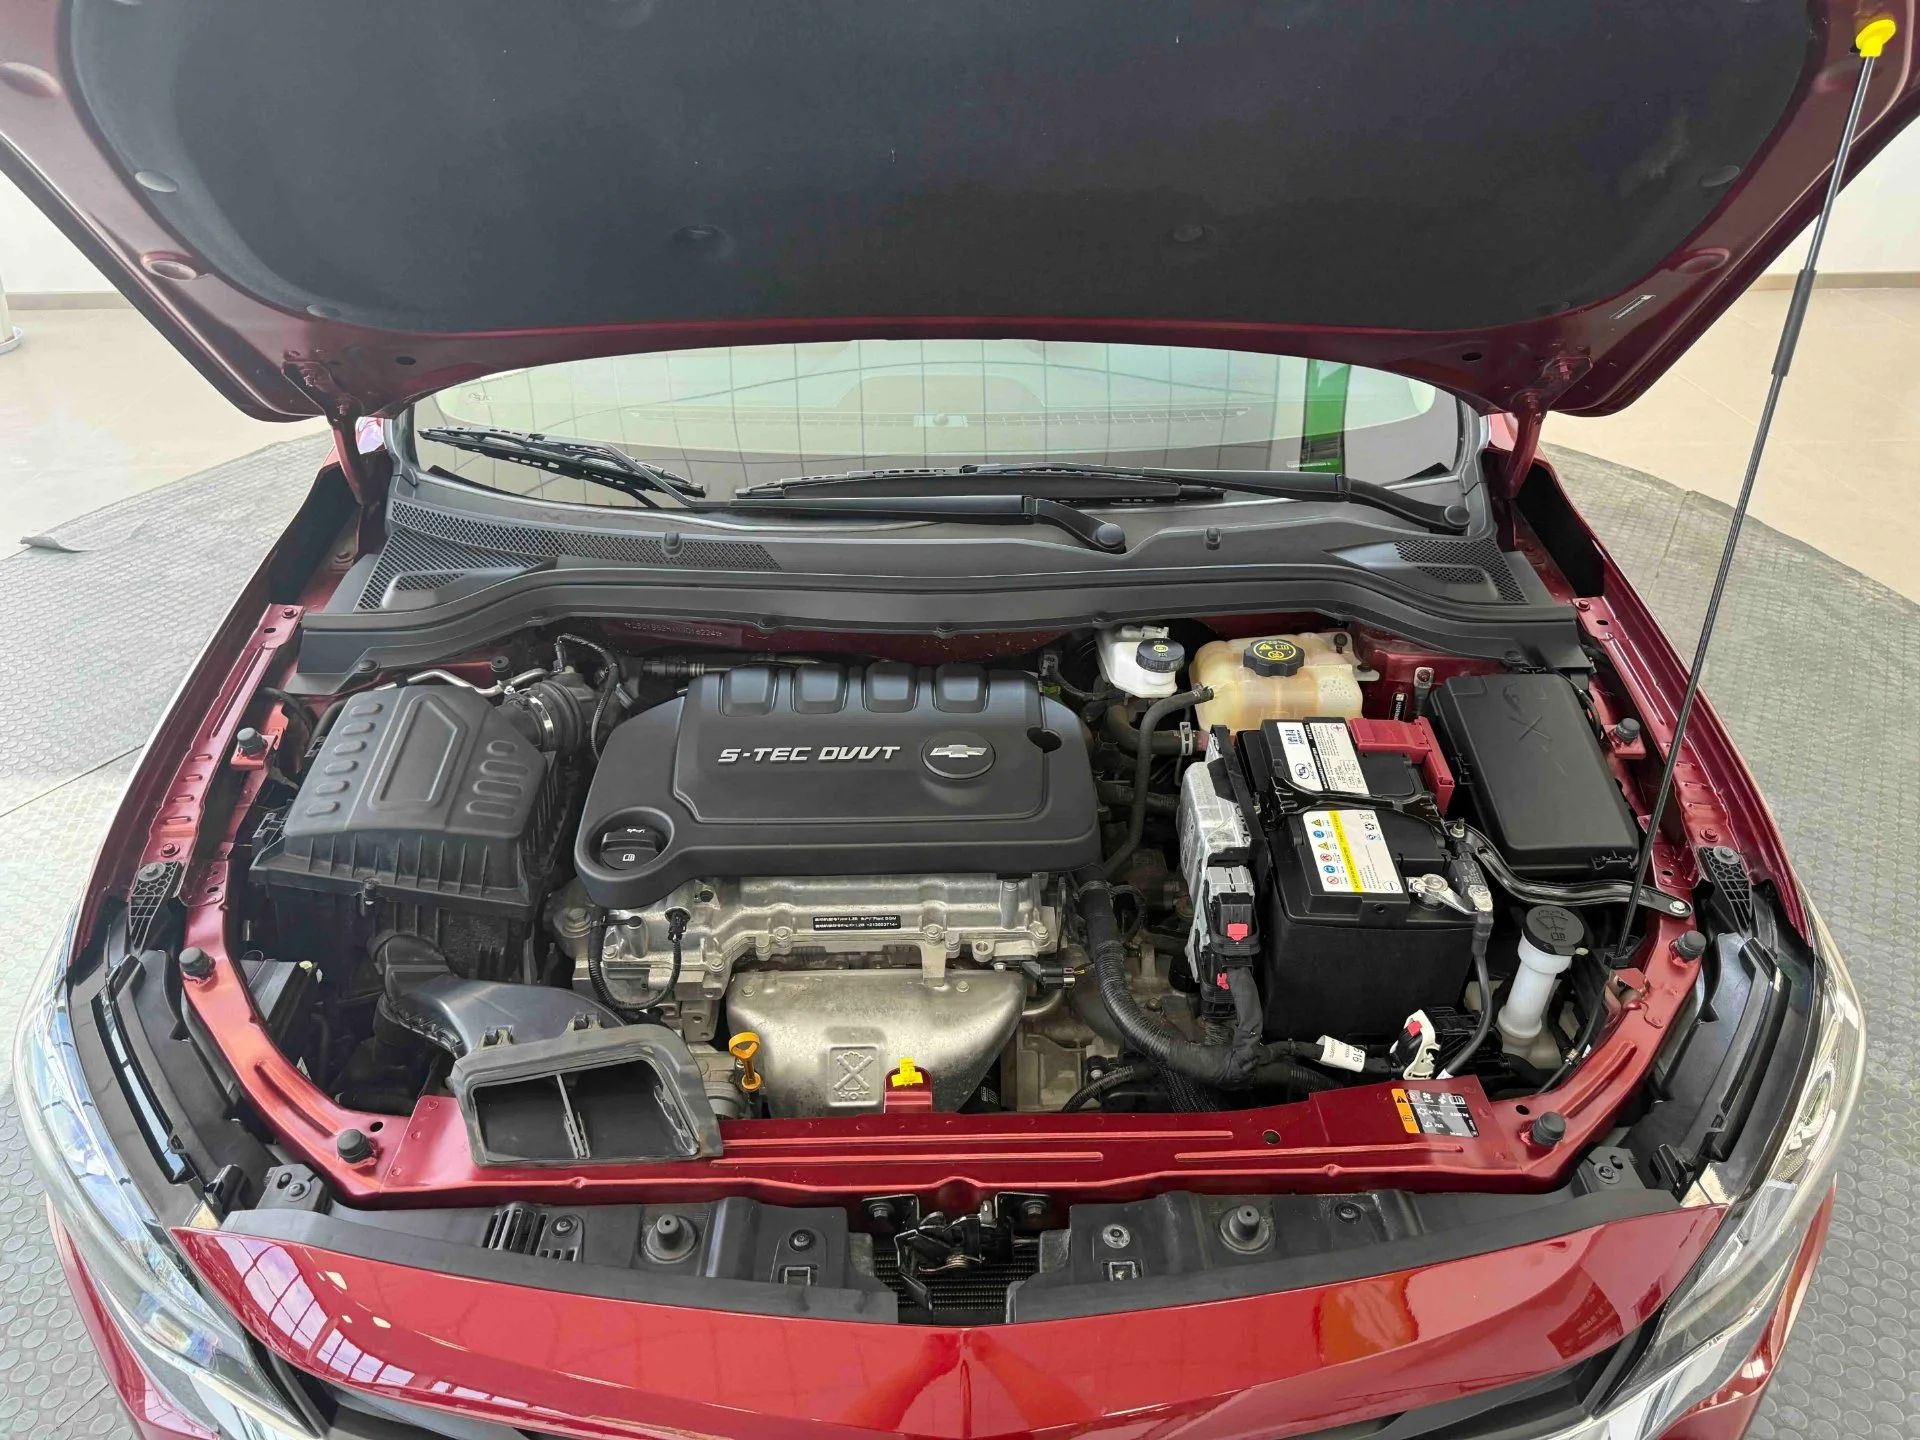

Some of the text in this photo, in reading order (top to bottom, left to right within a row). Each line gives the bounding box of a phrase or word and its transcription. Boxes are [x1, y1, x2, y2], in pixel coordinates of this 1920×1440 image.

[718, 746, 900, 762] S-TEC DVVT
[837, 1091, 870, 1101] HOT
